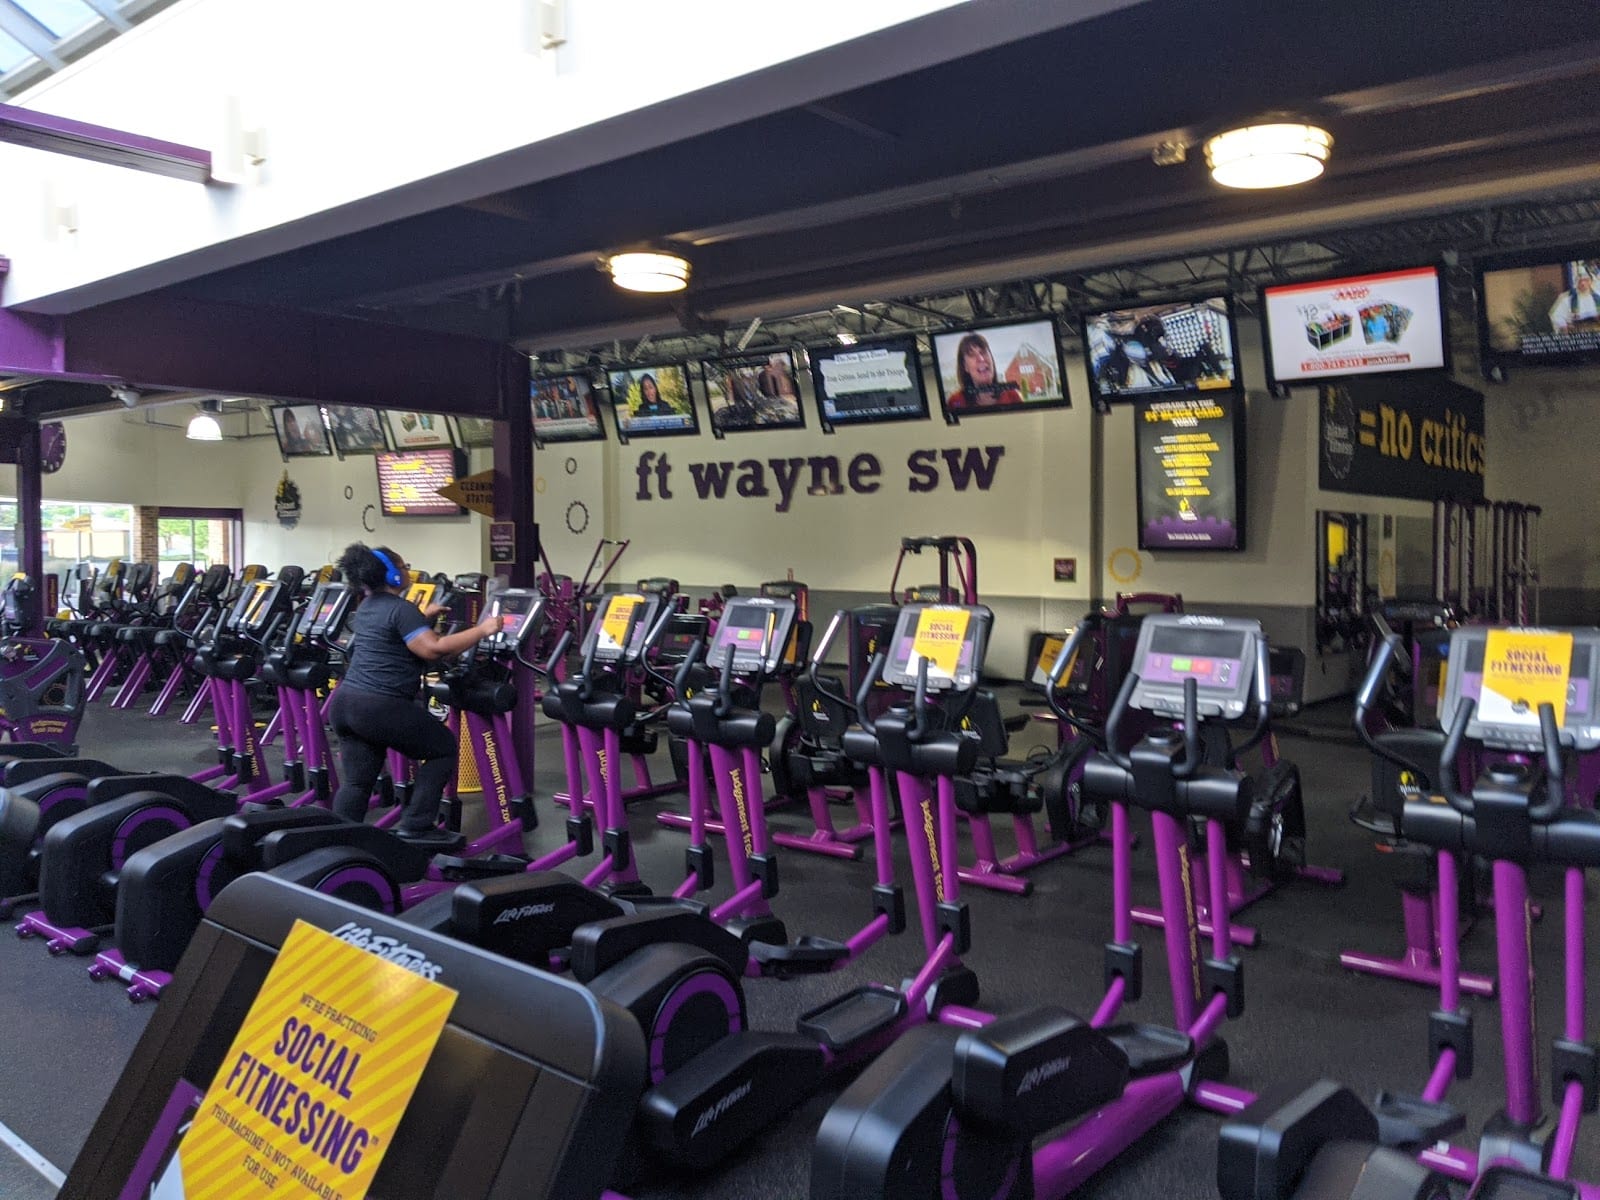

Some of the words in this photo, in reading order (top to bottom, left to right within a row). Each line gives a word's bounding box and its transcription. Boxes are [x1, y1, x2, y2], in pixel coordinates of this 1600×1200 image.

[1421, 407, 1486, 475] critics
[636, 451, 673, 500] ft
[689, 452, 881, 513] wayne
[907, 446, 1005, 492] sw
[1490, 660, 1563, 676] FITNESSING
[1505, 649, 1549, 663] SOCIAL
[482, 730, 502, 784] judgement
[323, 1006, 378, 1043] PRACTICING
[274, 1016, 361, 1100] SOCIAL
[212, 1104, 232, 1126] THIS
[227, 1116, 265, 1151] MACHINE
[262, 1139, 273, 1158] IS
[272, 1147, 293, 1171] NOT
[242, 1155, 260, 1176] FOR
[257, 1169, 279, 1190] USE
